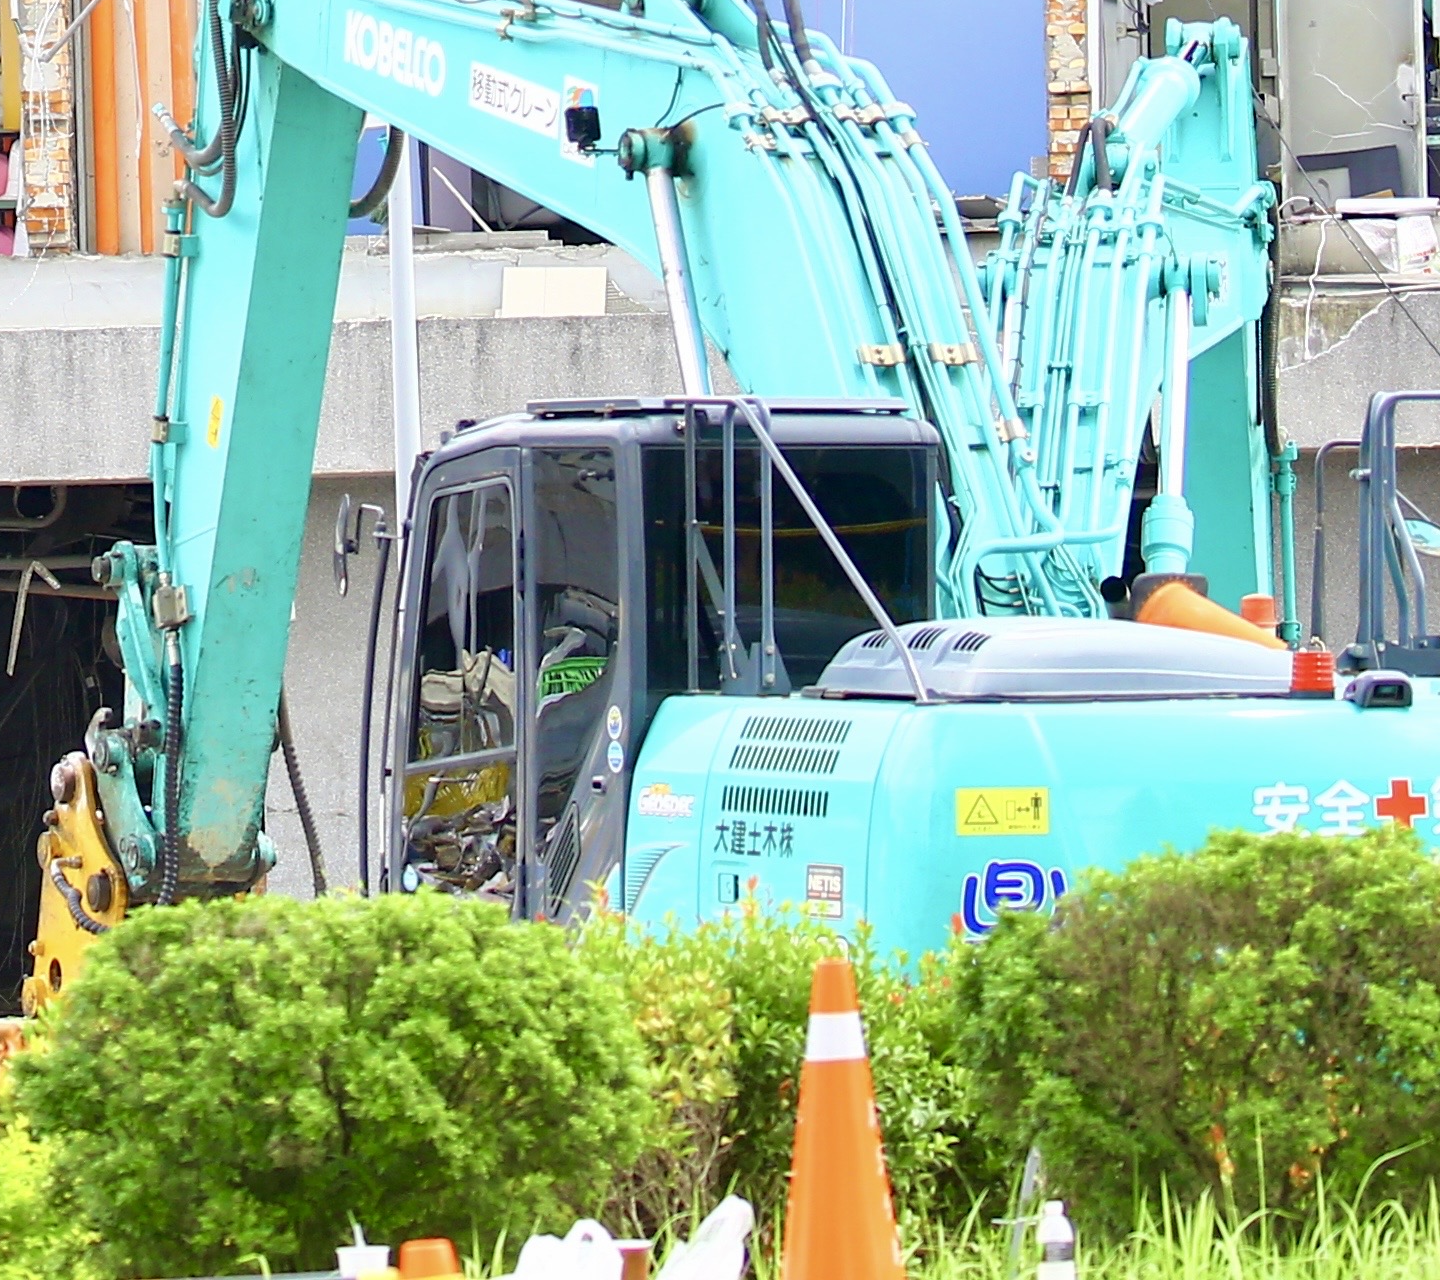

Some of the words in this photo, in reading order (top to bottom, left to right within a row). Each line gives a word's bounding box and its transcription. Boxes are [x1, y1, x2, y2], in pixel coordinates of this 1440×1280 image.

[345, 10, 446, 96] KOBELCO
[471, 67, 558, 127] 移動式クレーン
[1252, 780, 1370, 837] 安全
[713, 819, 795, 859] 大建土木株
[807, 873, 842, 893] NETIS
